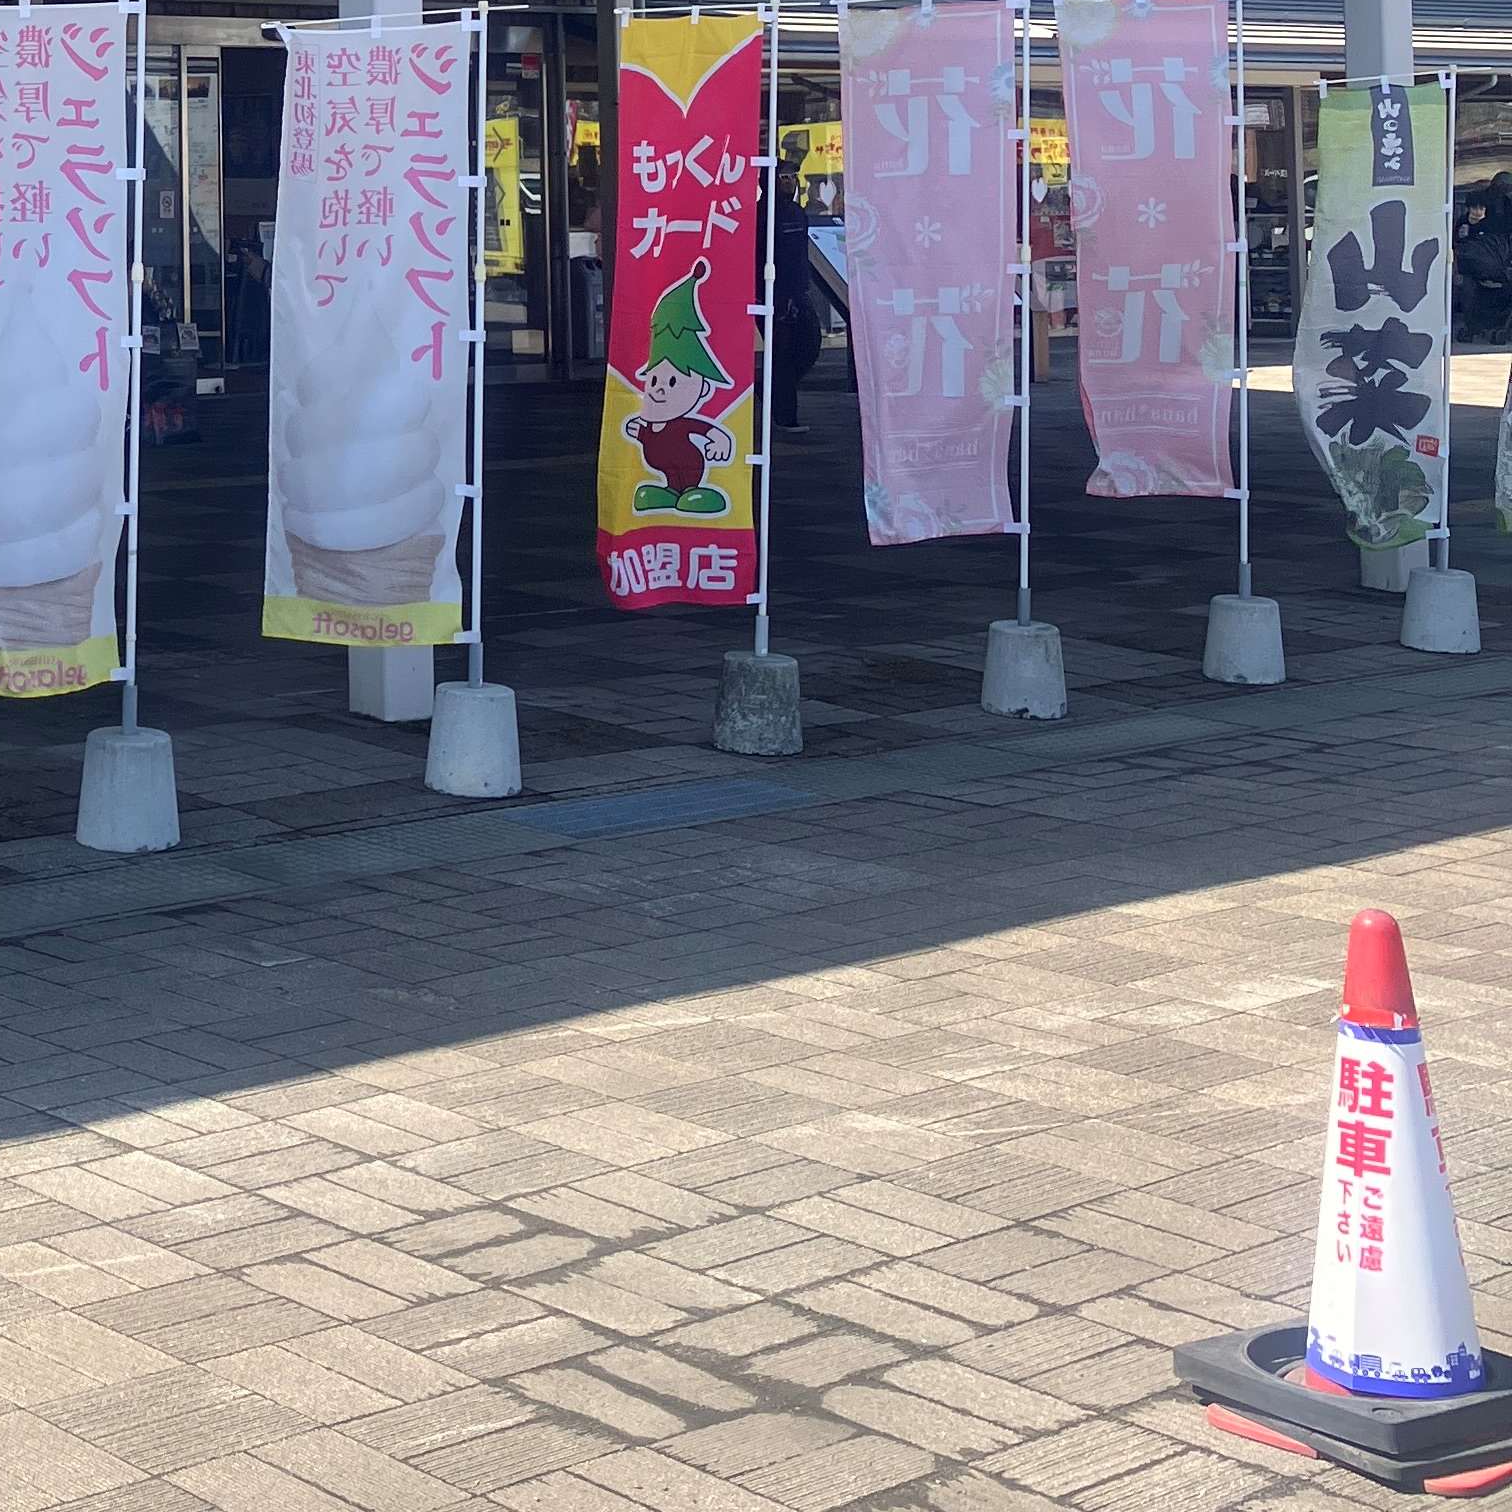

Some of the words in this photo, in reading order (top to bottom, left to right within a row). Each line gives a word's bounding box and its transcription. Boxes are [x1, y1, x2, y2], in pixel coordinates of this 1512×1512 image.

[632, 134, 746, 194] もっくん
[629, 195, 743, 260] カード
[607, 542, 738, 597] 加盟店
[1336, 1056, 1395, 1178] 駐車
[1336, 1178, 1355, 1264] 下さい
[1359, 1185, 1385, 1273] ご遠慮
